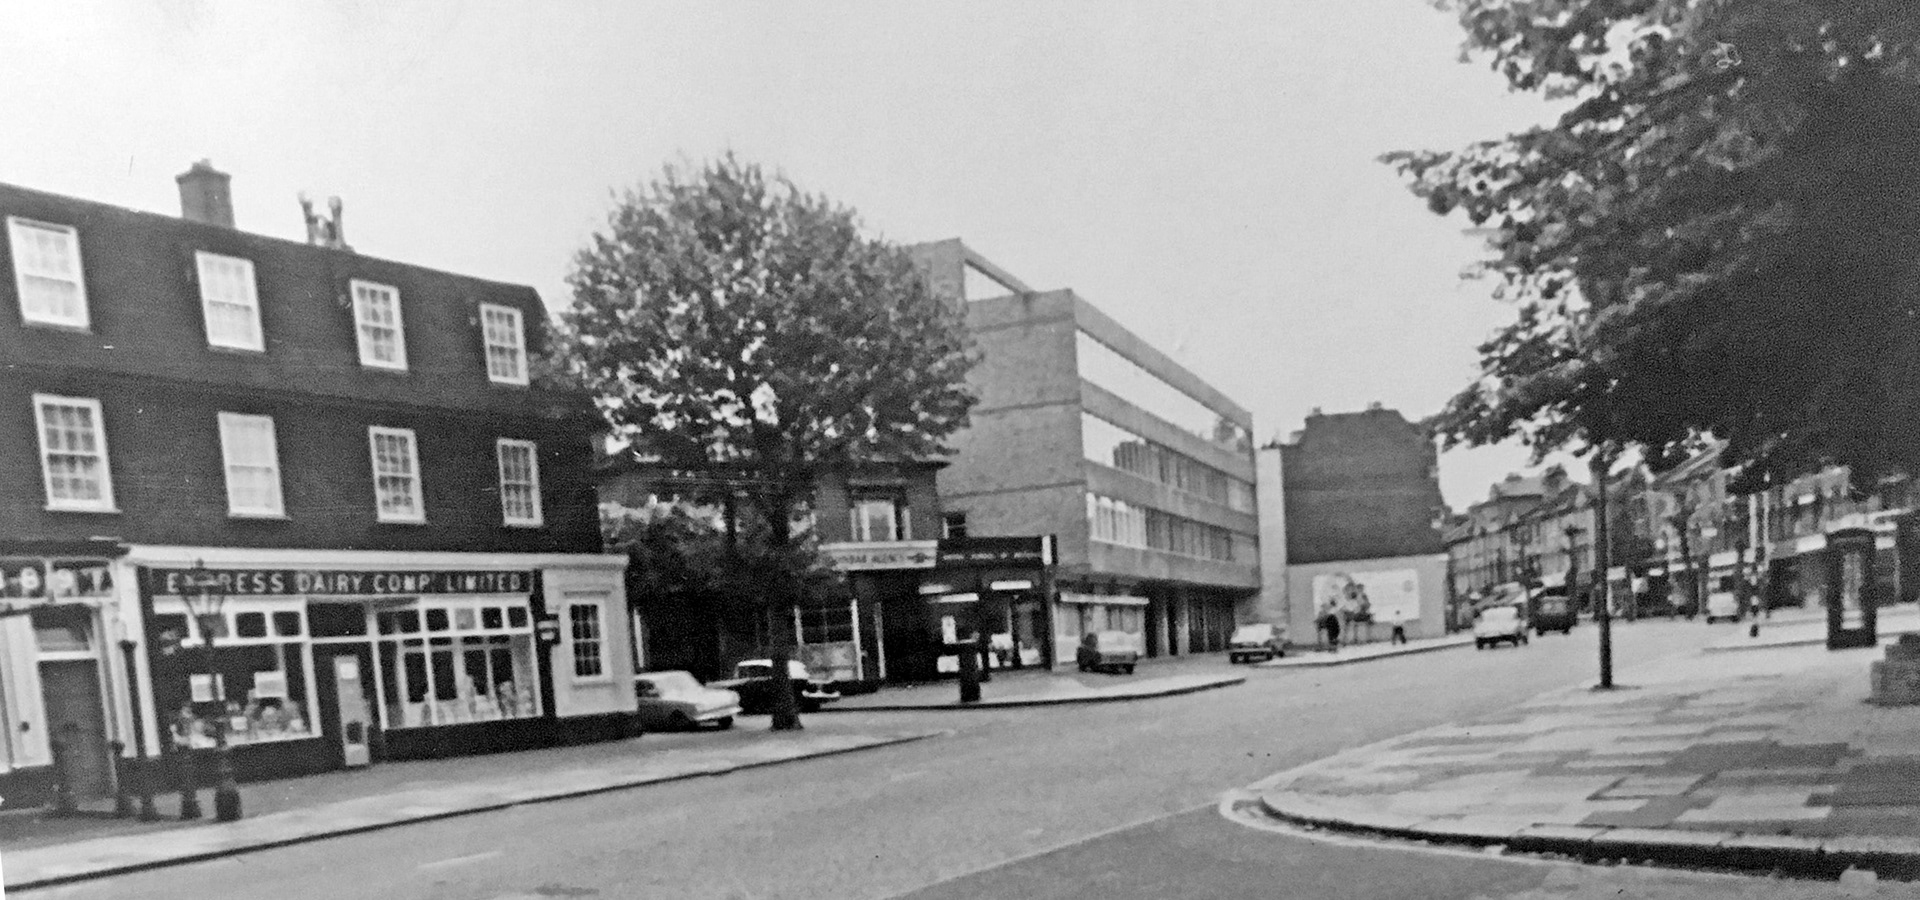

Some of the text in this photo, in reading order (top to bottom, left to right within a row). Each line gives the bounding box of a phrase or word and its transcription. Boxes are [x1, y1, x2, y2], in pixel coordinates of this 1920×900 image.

[167, 572, 284, 593] ERESS
[296, 573, 363, 593] DAIRY
[446, 573, 521, 592] LIMITED
